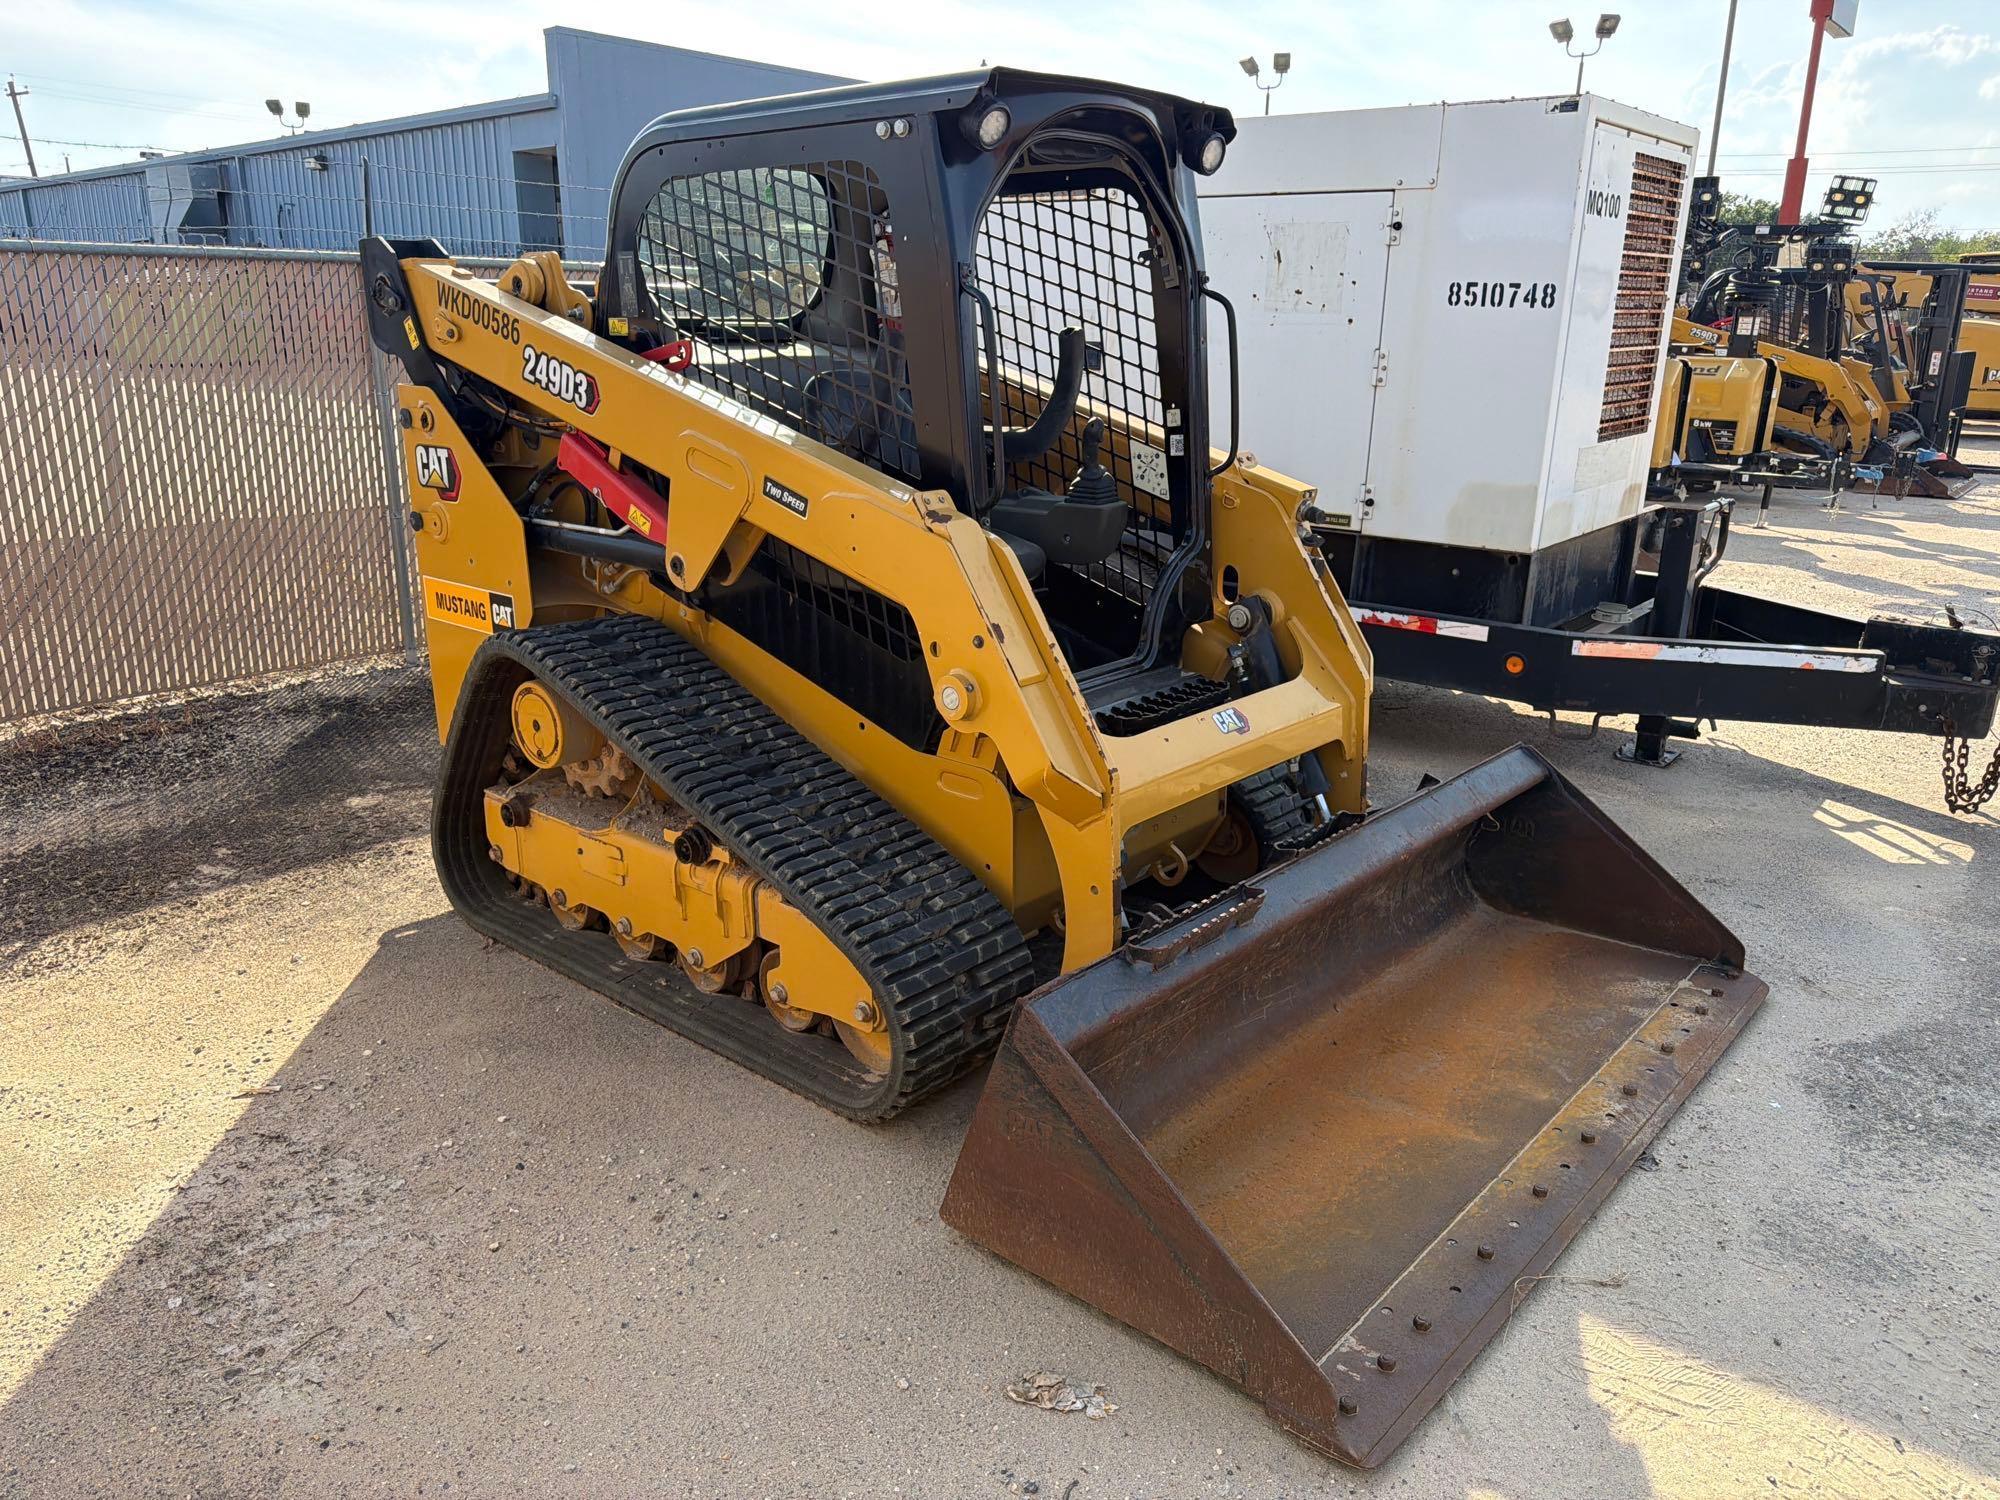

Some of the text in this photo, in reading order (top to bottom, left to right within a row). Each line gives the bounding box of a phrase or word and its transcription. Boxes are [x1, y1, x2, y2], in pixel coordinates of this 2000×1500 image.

[1586, 189, 1621, 219] MQ100
[1447, 281, 1557, 309] 8510748
[437, 280, 520, 345] WKD00586
[523, 346, 588, 410] 249D3
[1989, 369, 2000, 381] CA
[1693, 419, 1700, 427] 8
[415, 445, 449, 488] CAT
[435, 592, 512, 628] MUSTANG CAT
[1212, 708, 1244, 733] CAT
